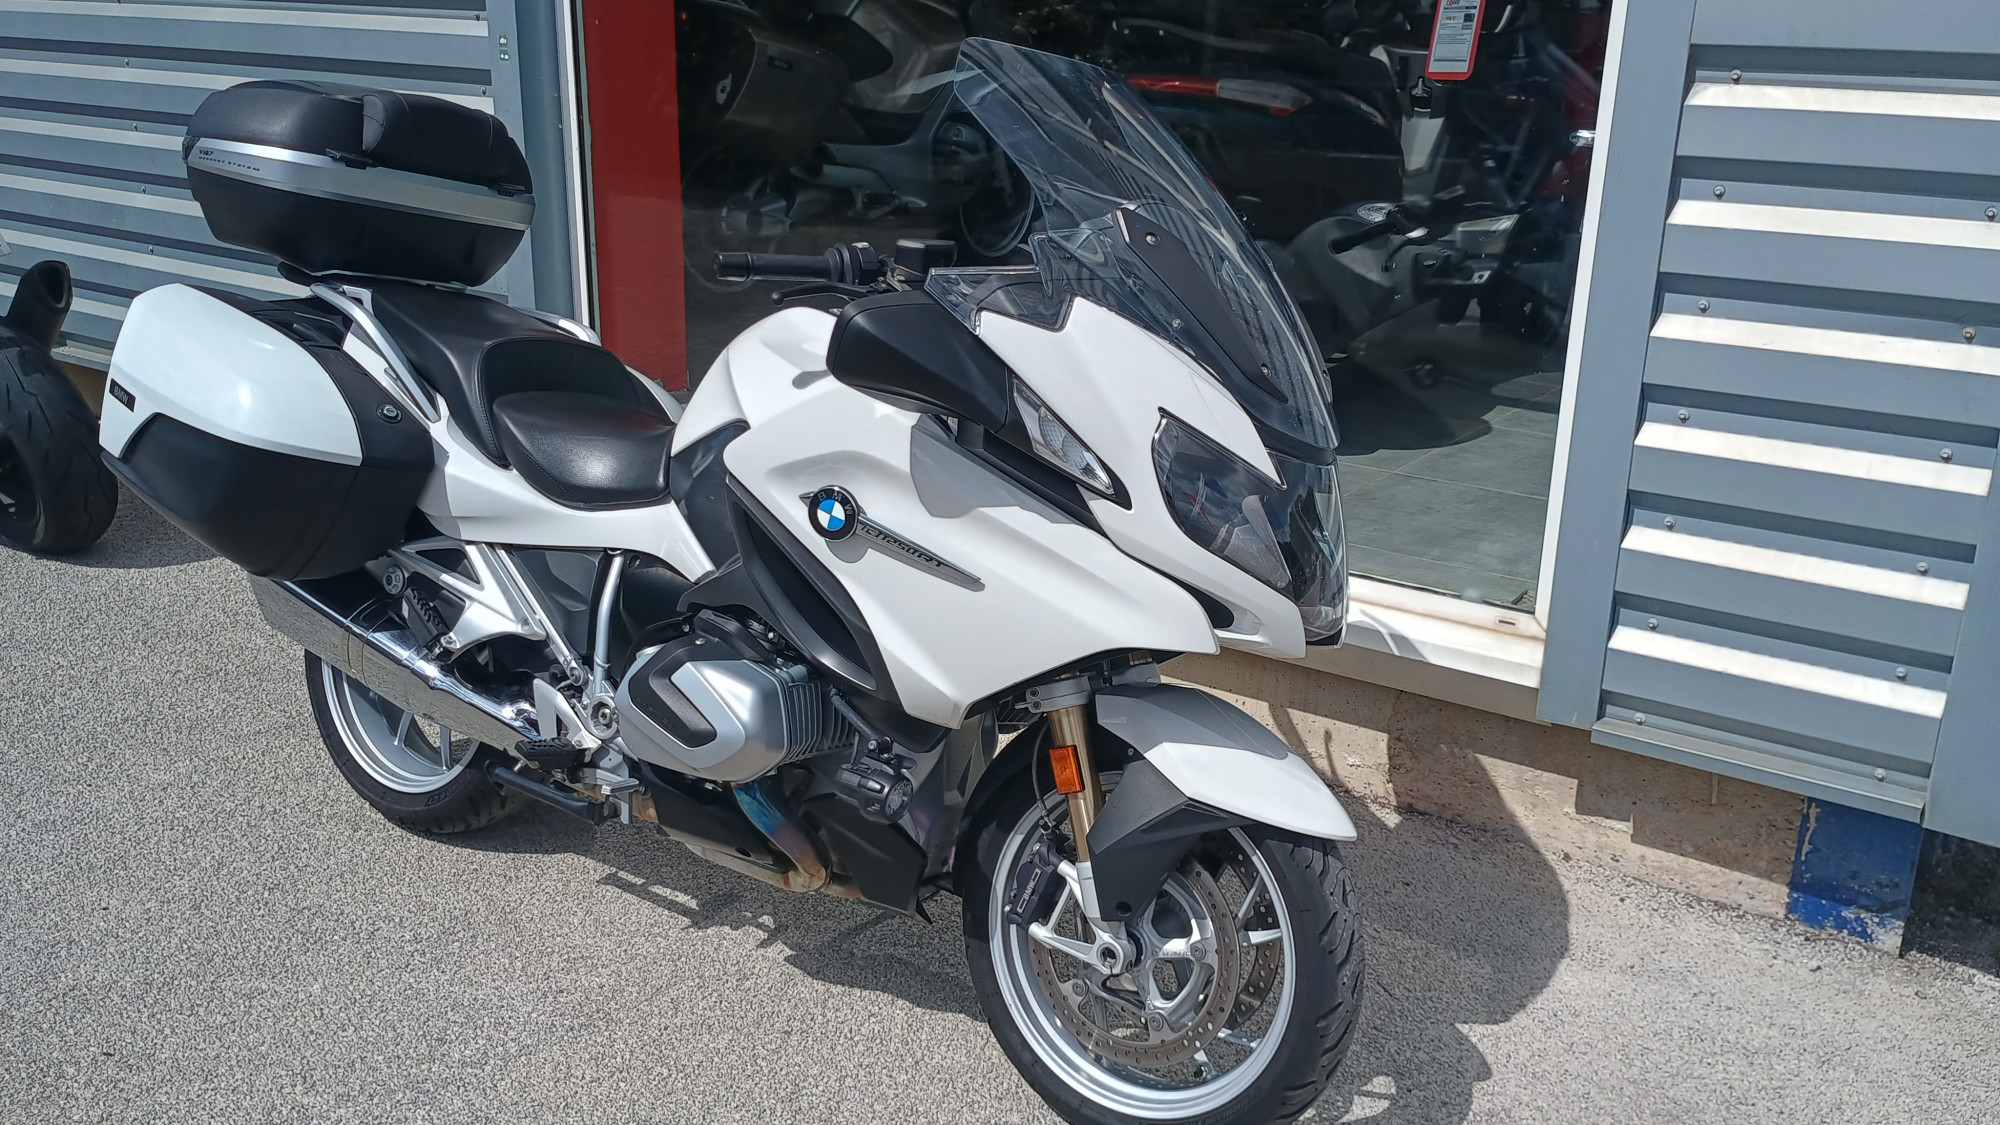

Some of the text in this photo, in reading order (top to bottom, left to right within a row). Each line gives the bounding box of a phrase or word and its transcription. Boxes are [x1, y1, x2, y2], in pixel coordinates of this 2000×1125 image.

[198, 149, 215, 157] V47
[113, 385, 129, 405] BMW
[817, 491, 854, 516] BMW
[1022, 879, 1036, 901] BMW
